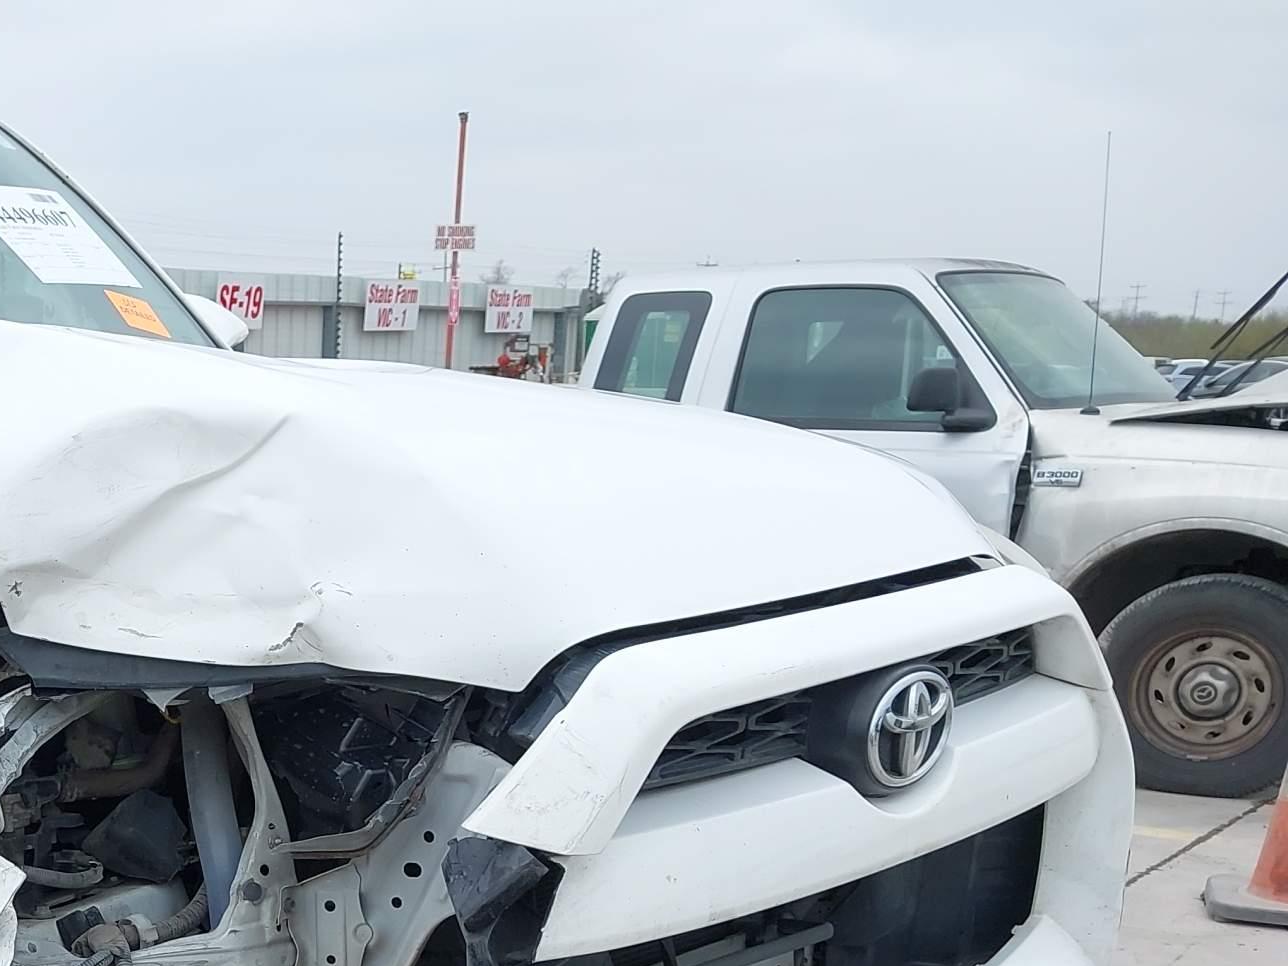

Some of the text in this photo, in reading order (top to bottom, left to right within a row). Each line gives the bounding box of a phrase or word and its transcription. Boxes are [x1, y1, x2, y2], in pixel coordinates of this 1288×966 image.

[437, 225, 474, 237] NO SMOKING
[435, 238, 476, 249] STOP ENGINES
[220, 284, 263, 319] SF-19
[368, 284, 419, 303] State Farm
[489, 289, 532, 307] State Farm
[377, 308, 393, 328] VIC
[401, 308, 408, 328] 1
[496, 311, 510, 329] VIC
[515, 311, 524, 329] 2
